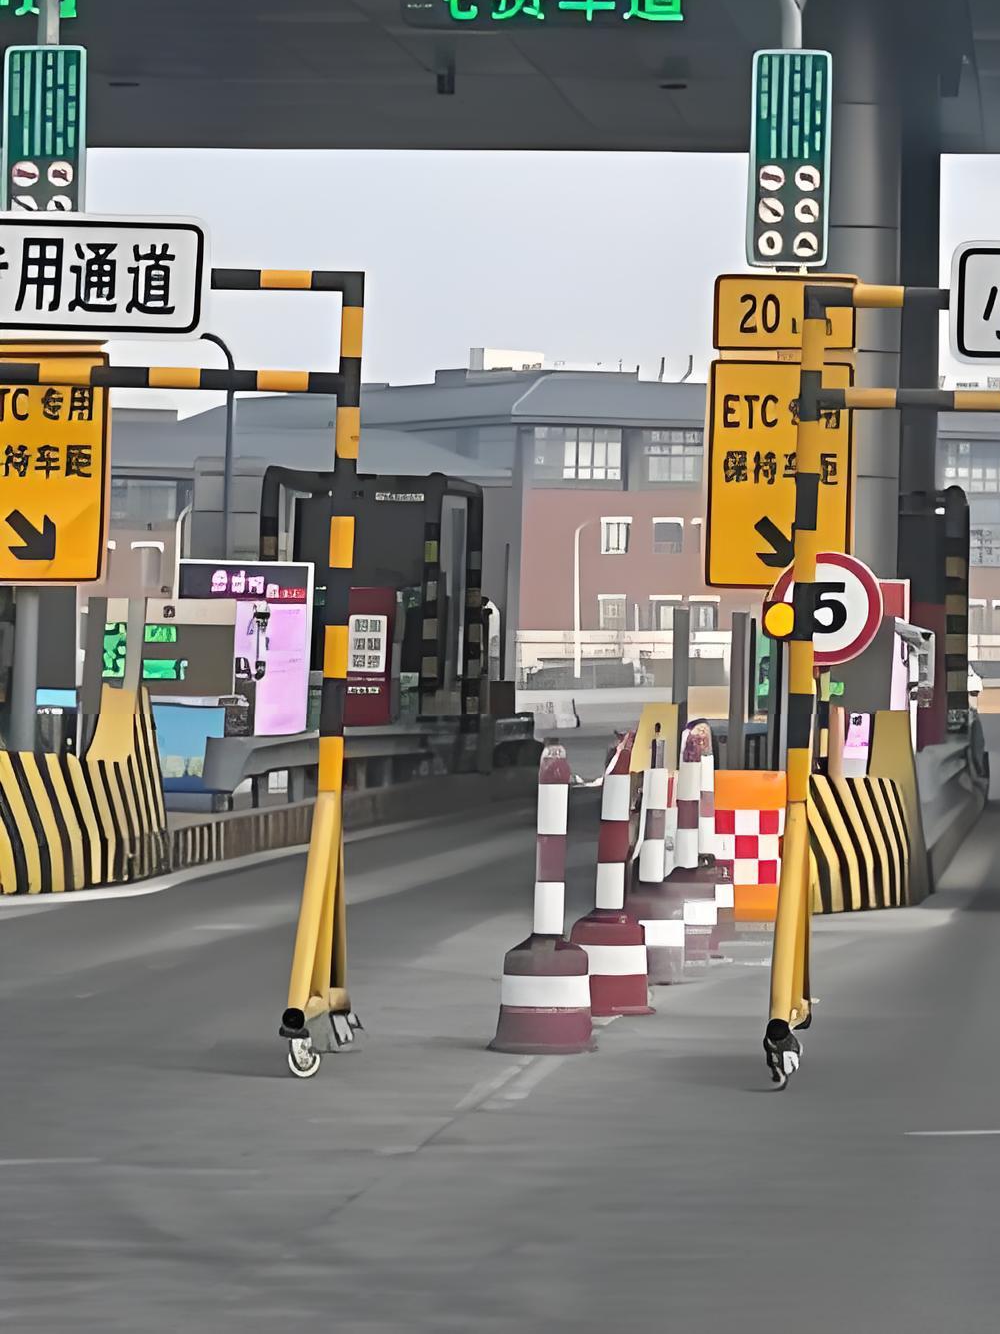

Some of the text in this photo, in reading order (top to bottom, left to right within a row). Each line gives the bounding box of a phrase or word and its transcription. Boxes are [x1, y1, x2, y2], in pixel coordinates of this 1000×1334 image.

[0, 237, 176, 315] 用通道
[722, 394, 779, 429] ETC
